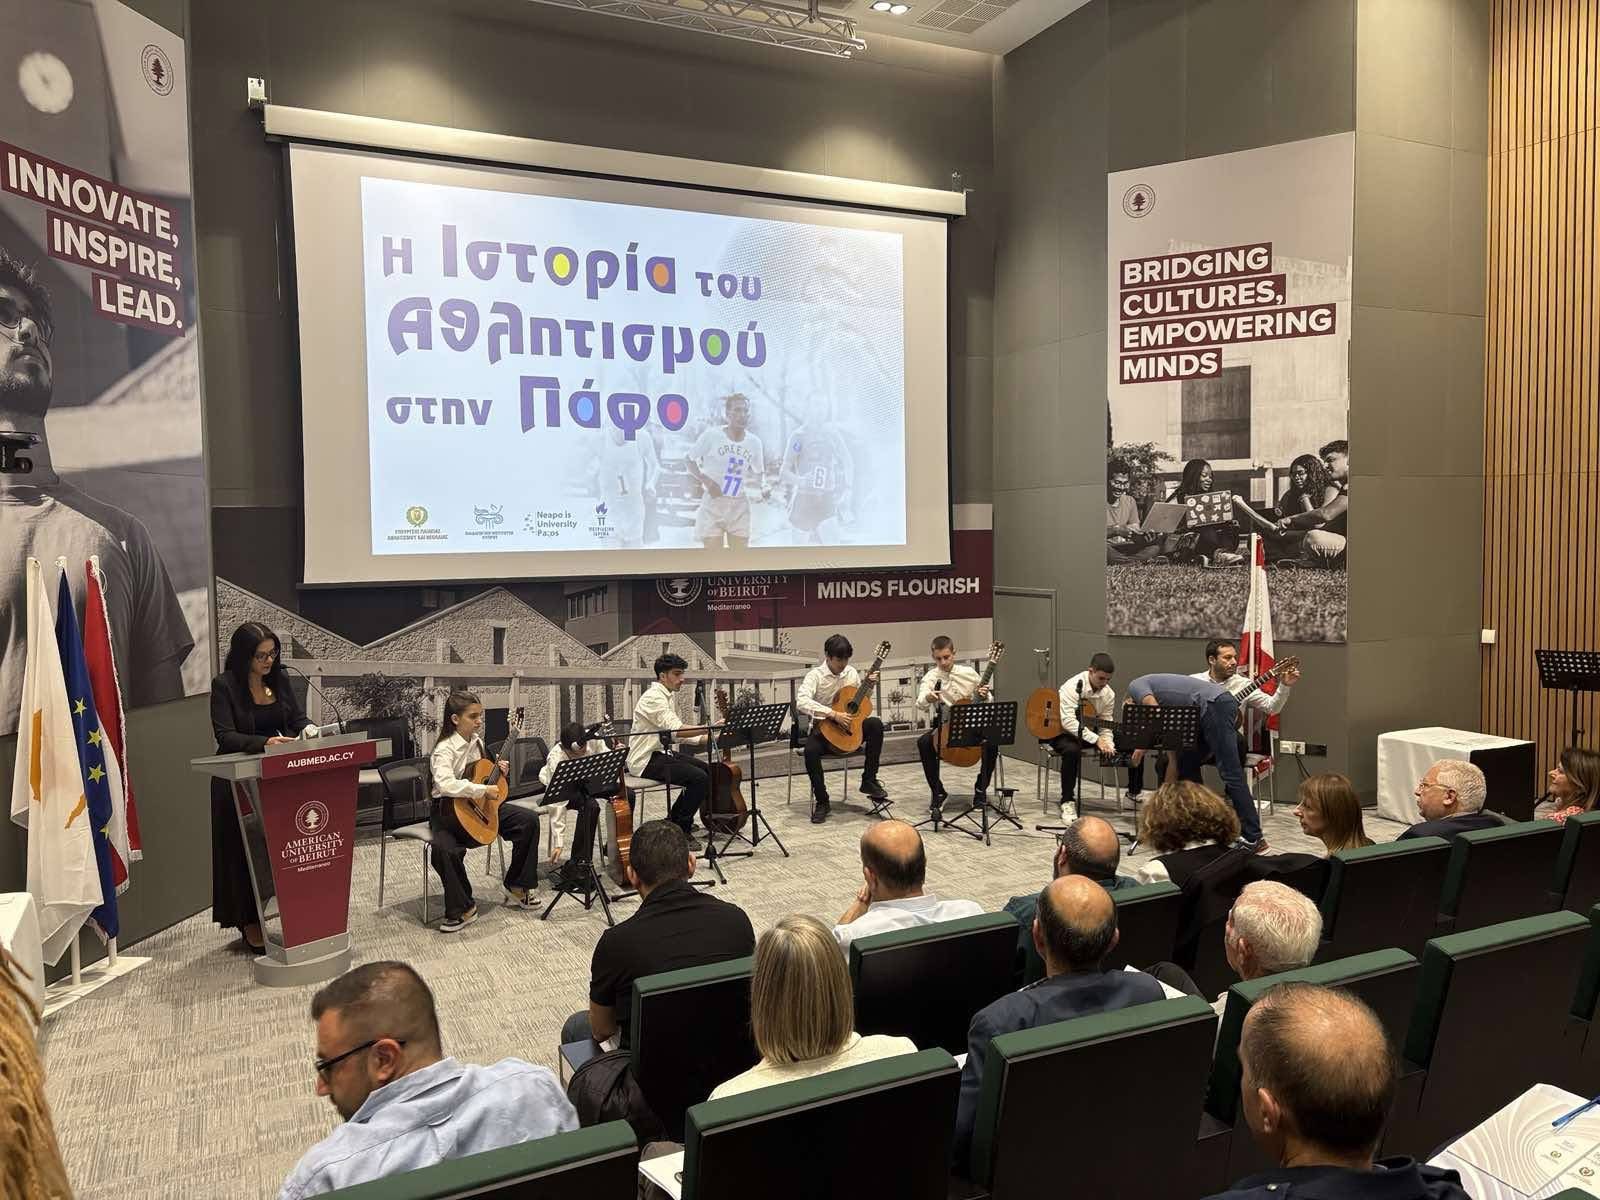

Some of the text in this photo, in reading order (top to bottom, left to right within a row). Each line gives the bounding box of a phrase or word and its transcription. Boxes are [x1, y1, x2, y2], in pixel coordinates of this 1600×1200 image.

[7, 152, 179, 247] INNOVATE,
[53, 218, 182, 290] INSPIRE,
[442, 224, 677, 300] Ιστορία
[695, 270, 762, 301] του
[1124, 247, 1269, 285] BRIDGING
[98, 279, 183, 328] LEAD.
[1123, 280, 1284, 316] CULTURES,
[388, 297, 767, 373] Αθλητισμού
[1124, 309, 1332, 348] EMPOWERING
[1124, 352, 1218, 380] MINDS
[386, 375, 689, 440] στην Πάφο
[723, 475, 743, 496] 77
[537, 511, 571, 520] Neapois
[537, 520, 577, 528] University
[707, 575, 789, 586] UNIVERSITY
[719, 585, 770, 597] BEIRUT
[817, 577, 980, 600] MINDS FLOURISH
[707, 603, 751, 612] Mediterraneo
[287, 752, 355, 768] AUBMED.AC.CY
[281, 839, 344, 859] UNIVERSITY
[285, 831, 341, 849] AMERICAN
[299, 848, 337, 863] BEIRUT
